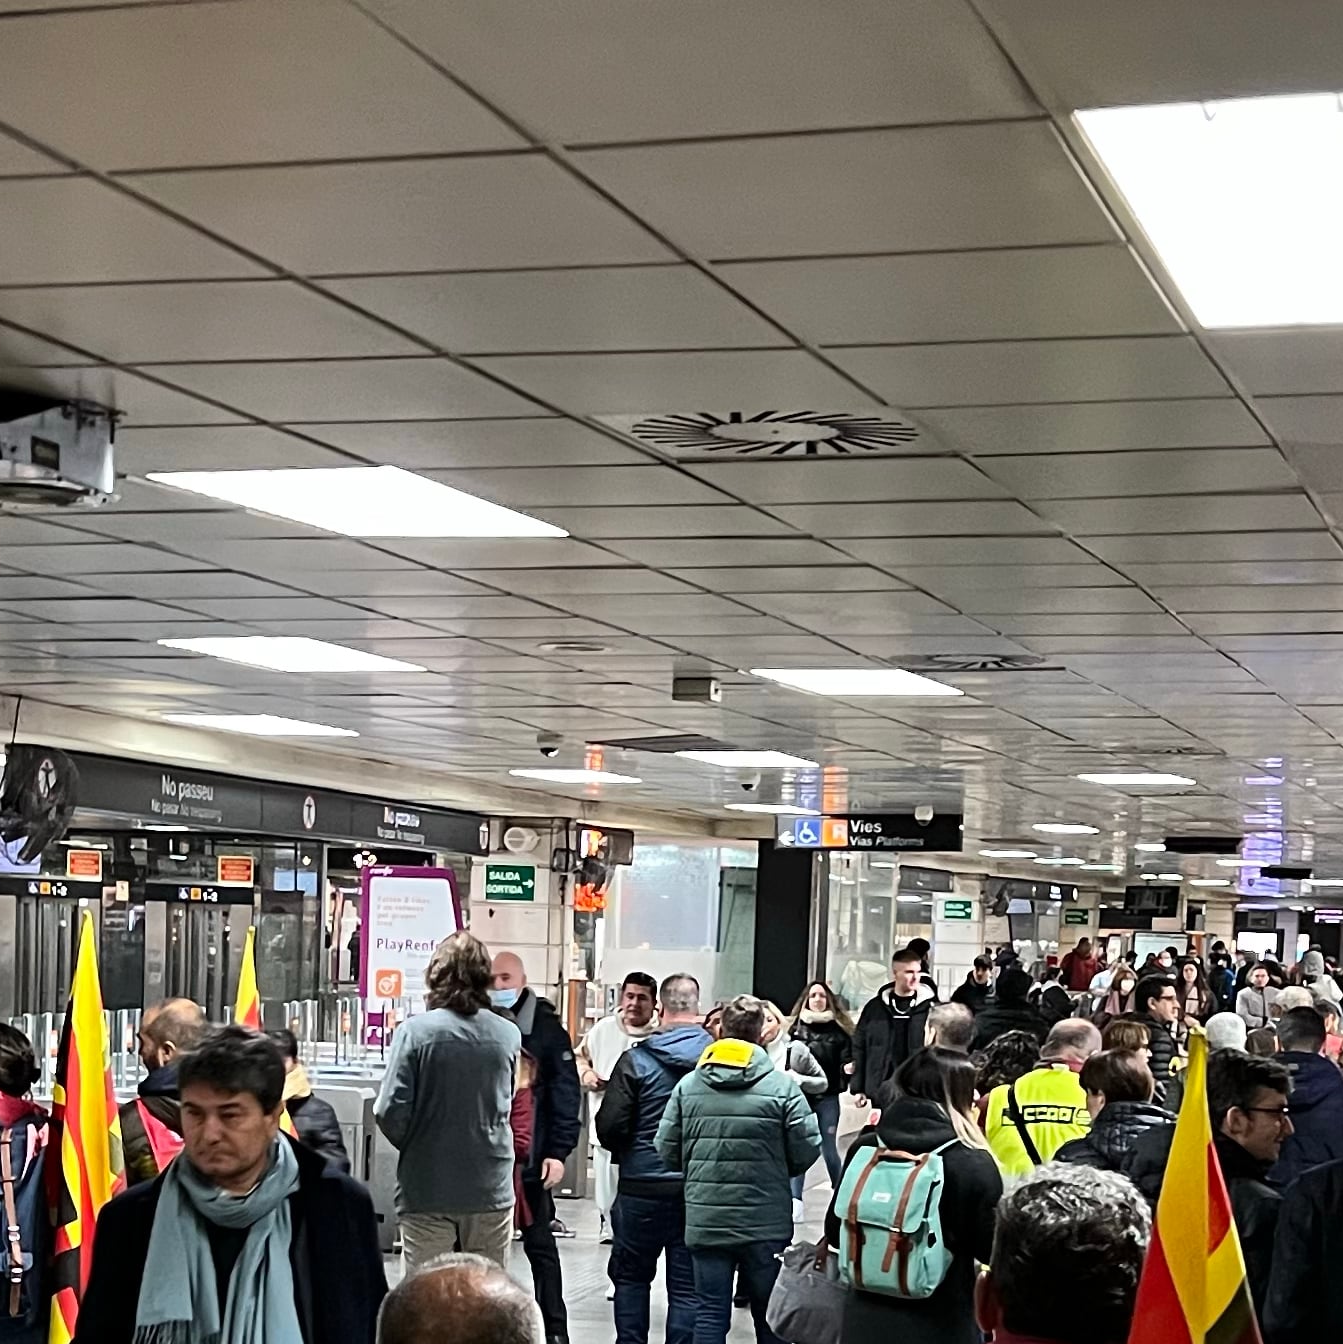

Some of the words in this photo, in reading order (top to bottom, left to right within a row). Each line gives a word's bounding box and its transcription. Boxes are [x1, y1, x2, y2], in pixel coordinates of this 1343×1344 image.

[161, 774, 176, 796] No
[850, 819, 882, 833] Vies
[850, 836, 872, 846] Vias
[488, 871, 521, 881] SALIDA
[486, 884, 523, 894] SORTIDA
[376, 938, 438, 952] PlayRenf
[1023, 1106, 1073, 1121] CCOO
